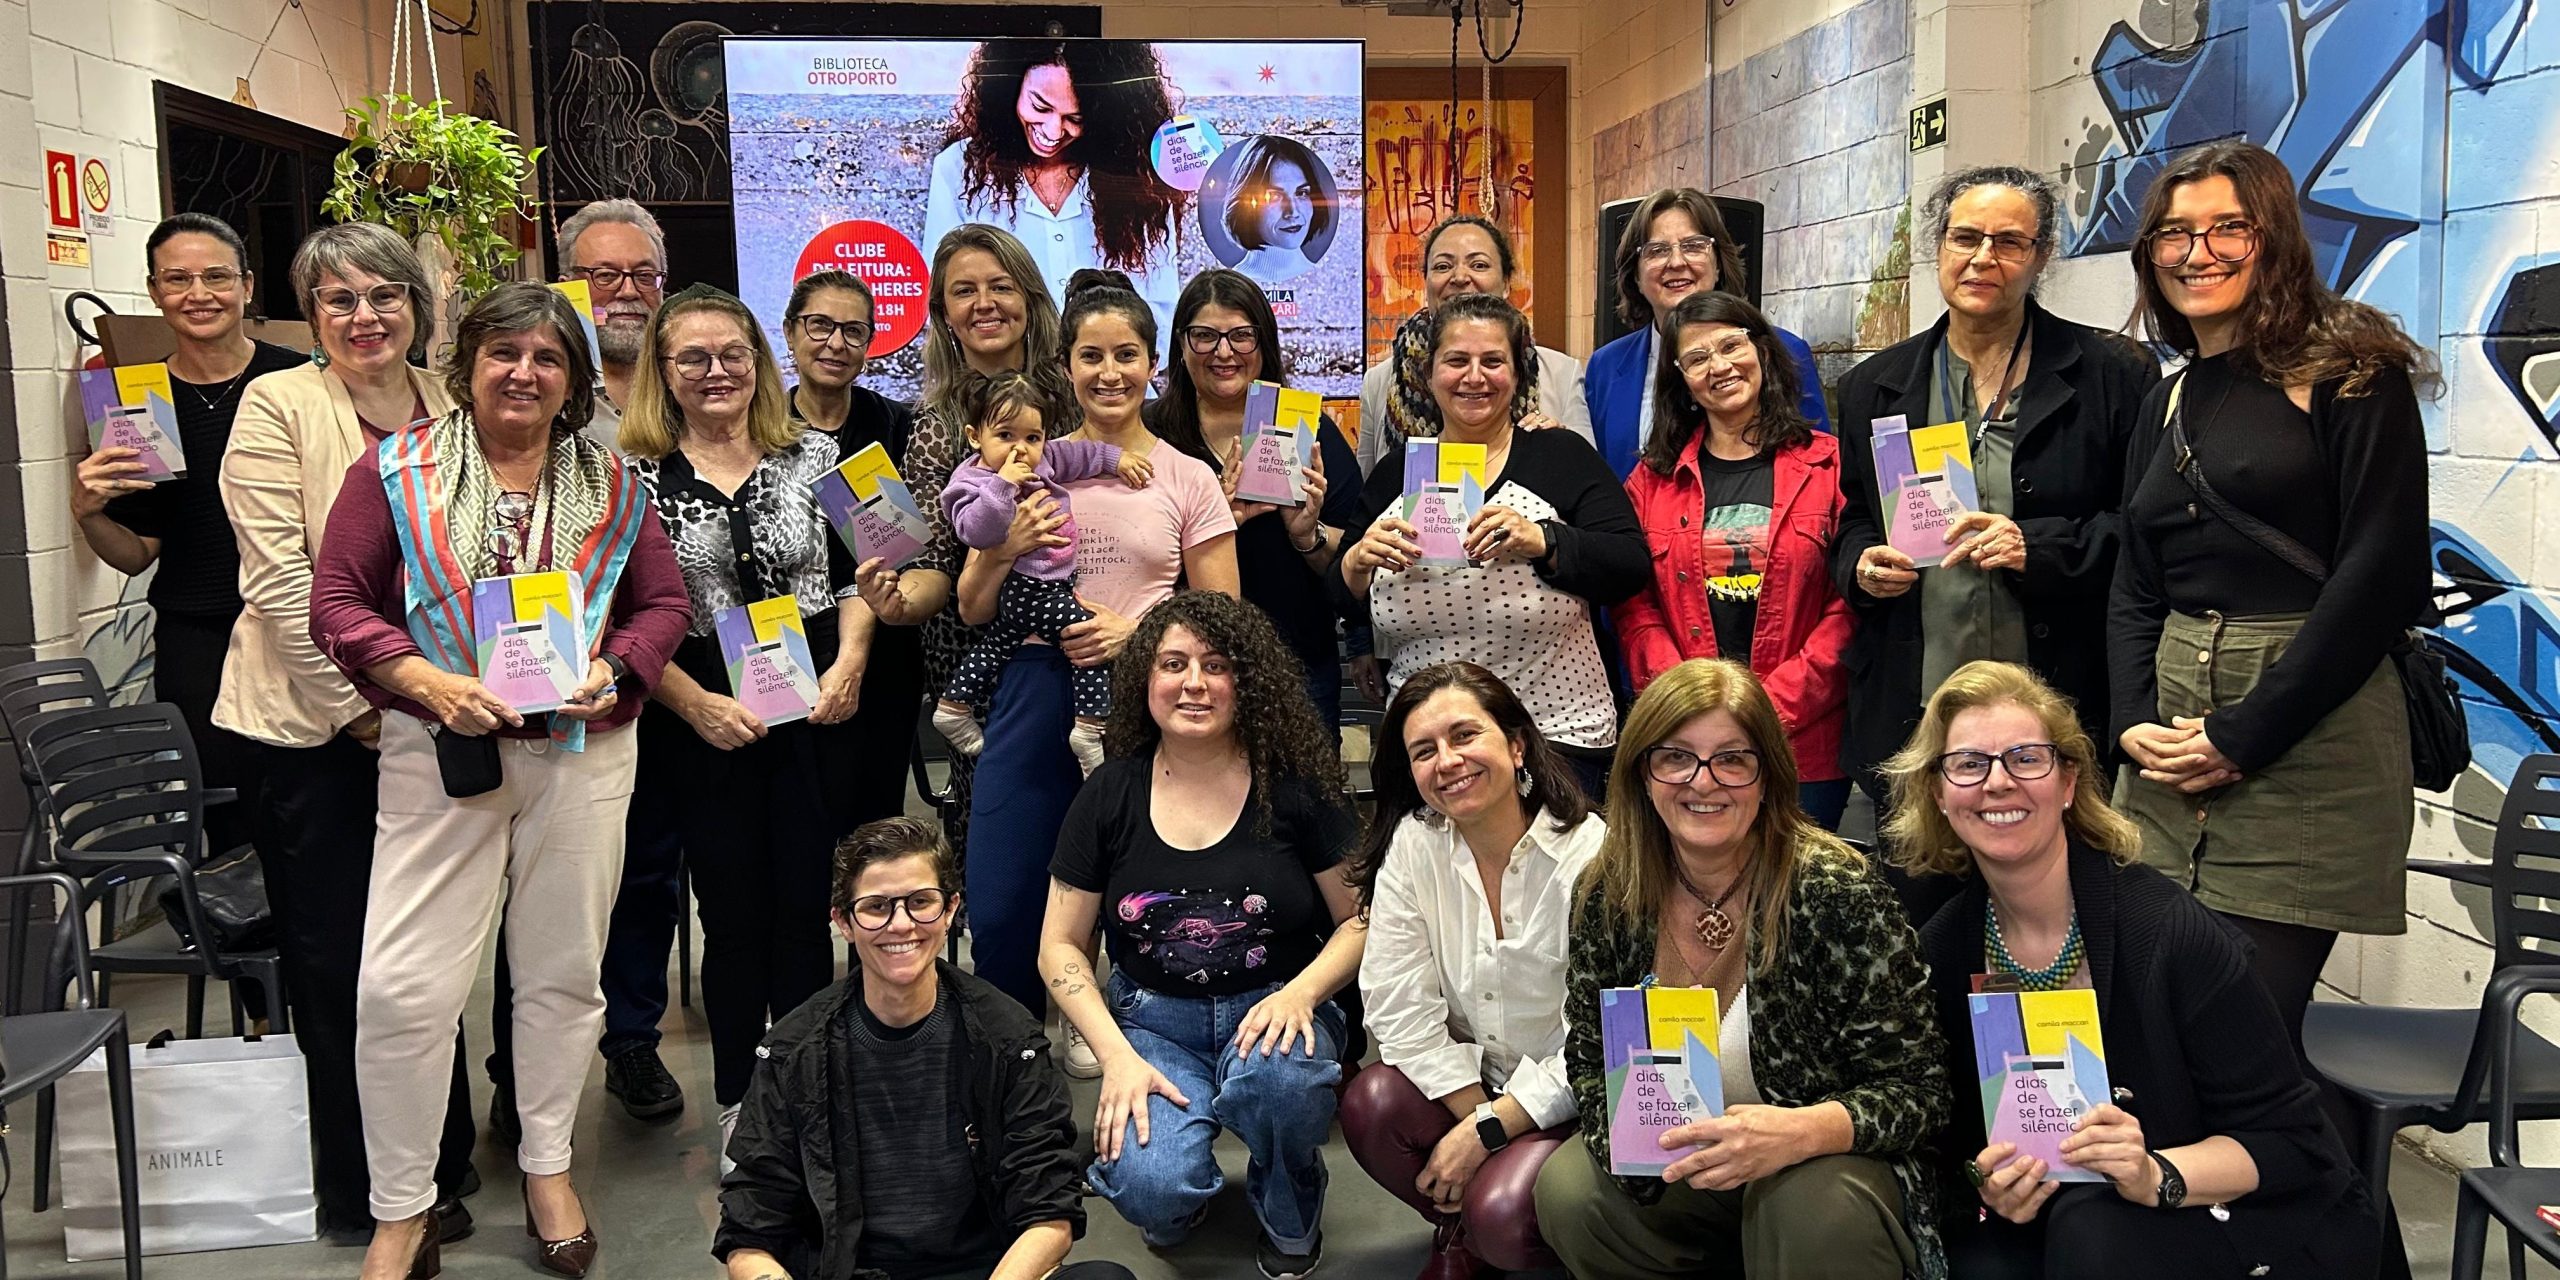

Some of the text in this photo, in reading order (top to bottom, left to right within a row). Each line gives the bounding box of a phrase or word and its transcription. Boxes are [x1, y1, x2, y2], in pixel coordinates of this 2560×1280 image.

[814, 57, 888, 70] BIBLIOTECA
[808, 71, 897, 85] OTROPORTO
[1167, 135, 1187, 146] dias
[1170, 146, 1182, 155] de
[1172, 150, 1206, 164] se fazer
[1174, 159, 1209, 174] silêncio
[834, 243, 886, 258] CLUBE
[871, 282, 923, 297] HERES
[877, 303, 905, 316] 18H
[112, 419, 135, 428] dias
[114, 428, 129, 437] de
[116, 439, 129, 447] se
[1261, 438, 1281, 448] dias
[1260, 446, 1273, 455] de
[1258, 456, 1293, 467] se fazer
[1257, 464, 1292, 476] silêncio
[1425, 496, 1446, 505] dias
[1907, 489, 1931, 500] dias
[1424, 505, 1438, 514] de
[1908, 500, 1924, 510] de
[858, 510, 878, 525] dias
[1423, 515, 1461, 525] se fazer
[1910, 507, 1954, 521] se fazer
[863, 522, 876, 533] de
[868, 517, 901, 542] se fazer
[1423, 524, 1461, 534] silêncio
[1912, 517, 1955, 531] silêncio
[873, 525, 906, 549] silêncio
[503, 638, 529, 648] dias
[504, 649, 521, 659] de
[505, 655, 551, 669] se fazer
[750, 656, 772, 667] dias
[506, 666, 551, 680] silêncio
[753, 667, 767, 676] de
[755, 670, 793, 685] se fazer
[757, 680, 796, 695] silêncio
[1636, 1069, 1665, 1083] dias
[2015, 1076, 2048, 1089] dias
[1637, 1084, 1655, 1097] de
[2017, 1091, 2037, 1104] de
[1638, 1098, 1692, 1112] se fazer
[2019, 1104, 2078, 1118] se fazer
[148, 1149, 224, 1171] ANIMALE
